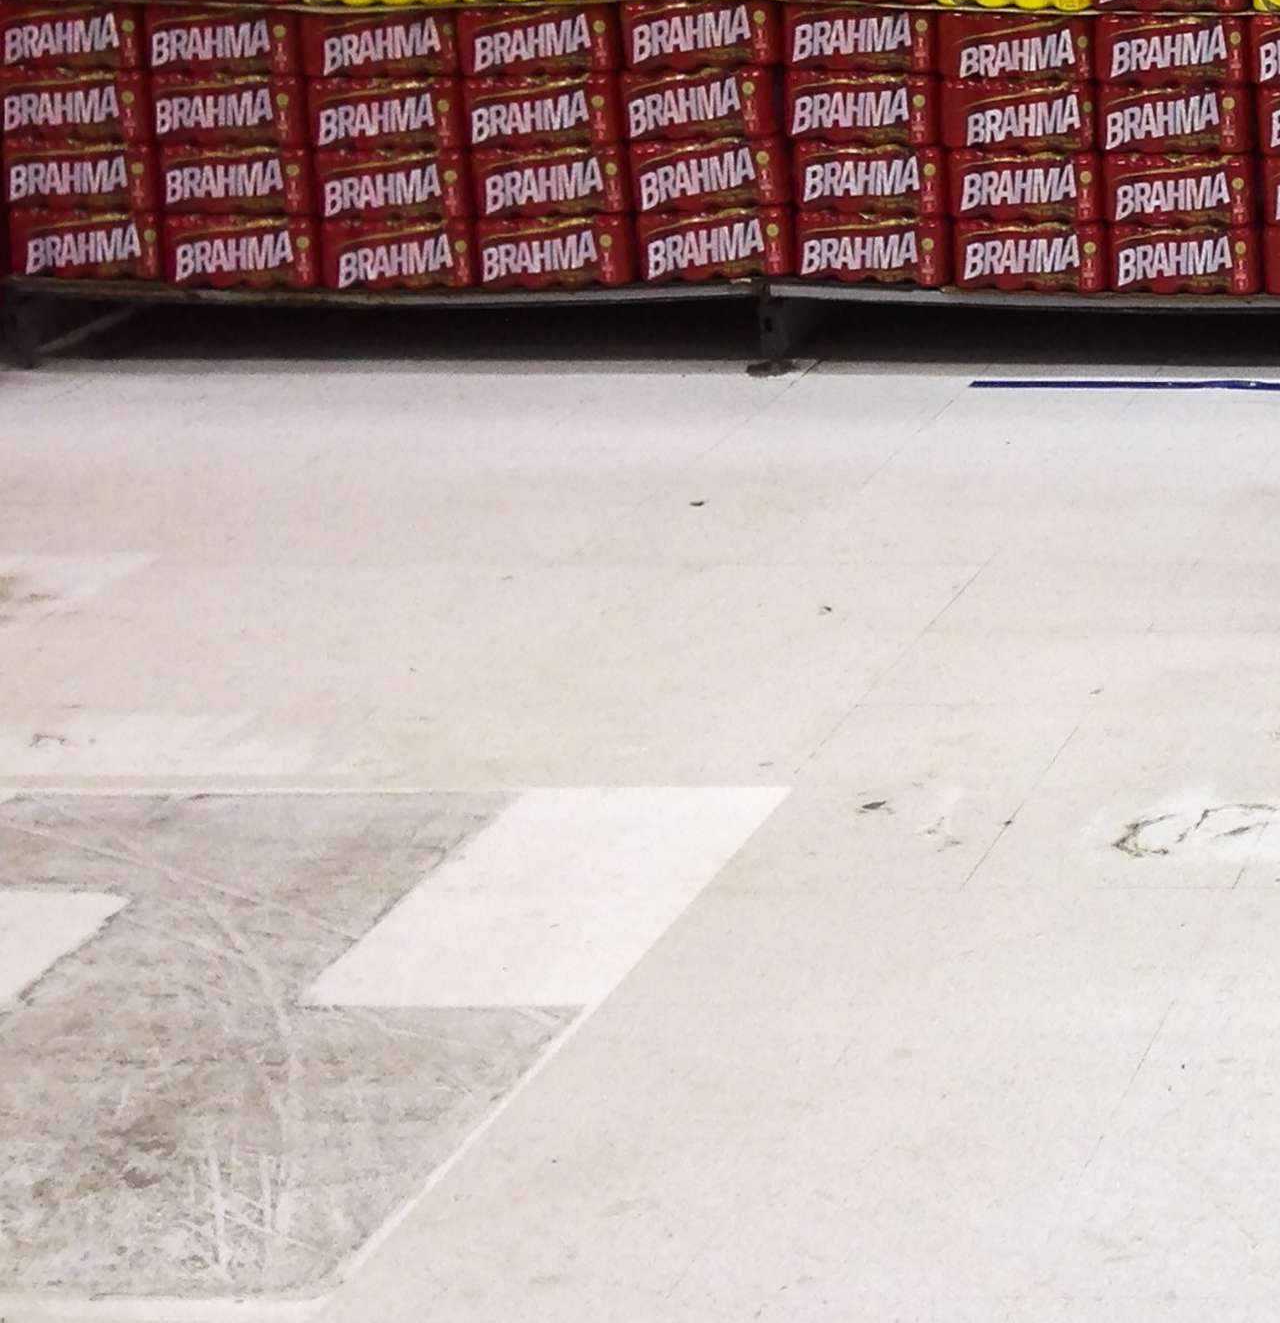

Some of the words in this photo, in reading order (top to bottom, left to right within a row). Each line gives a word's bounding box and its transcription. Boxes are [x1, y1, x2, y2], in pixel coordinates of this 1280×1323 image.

[5, 13, 119, 63] BRAHMA
[324, 17, 441, 76] BRAHMA
[633, 5, 751, 64] BRAHMA
[967, 86, 1081, 146] BRAHMA
[640, 147, 756, 211] BRAHMA
[26, 223, 141, 274] BRAHMA
[483, 230, 598, 282] BRAHMA
[801, 231, 918, 275] BRAHMA
[1118, 236, 1232, 286] BRAHMA
